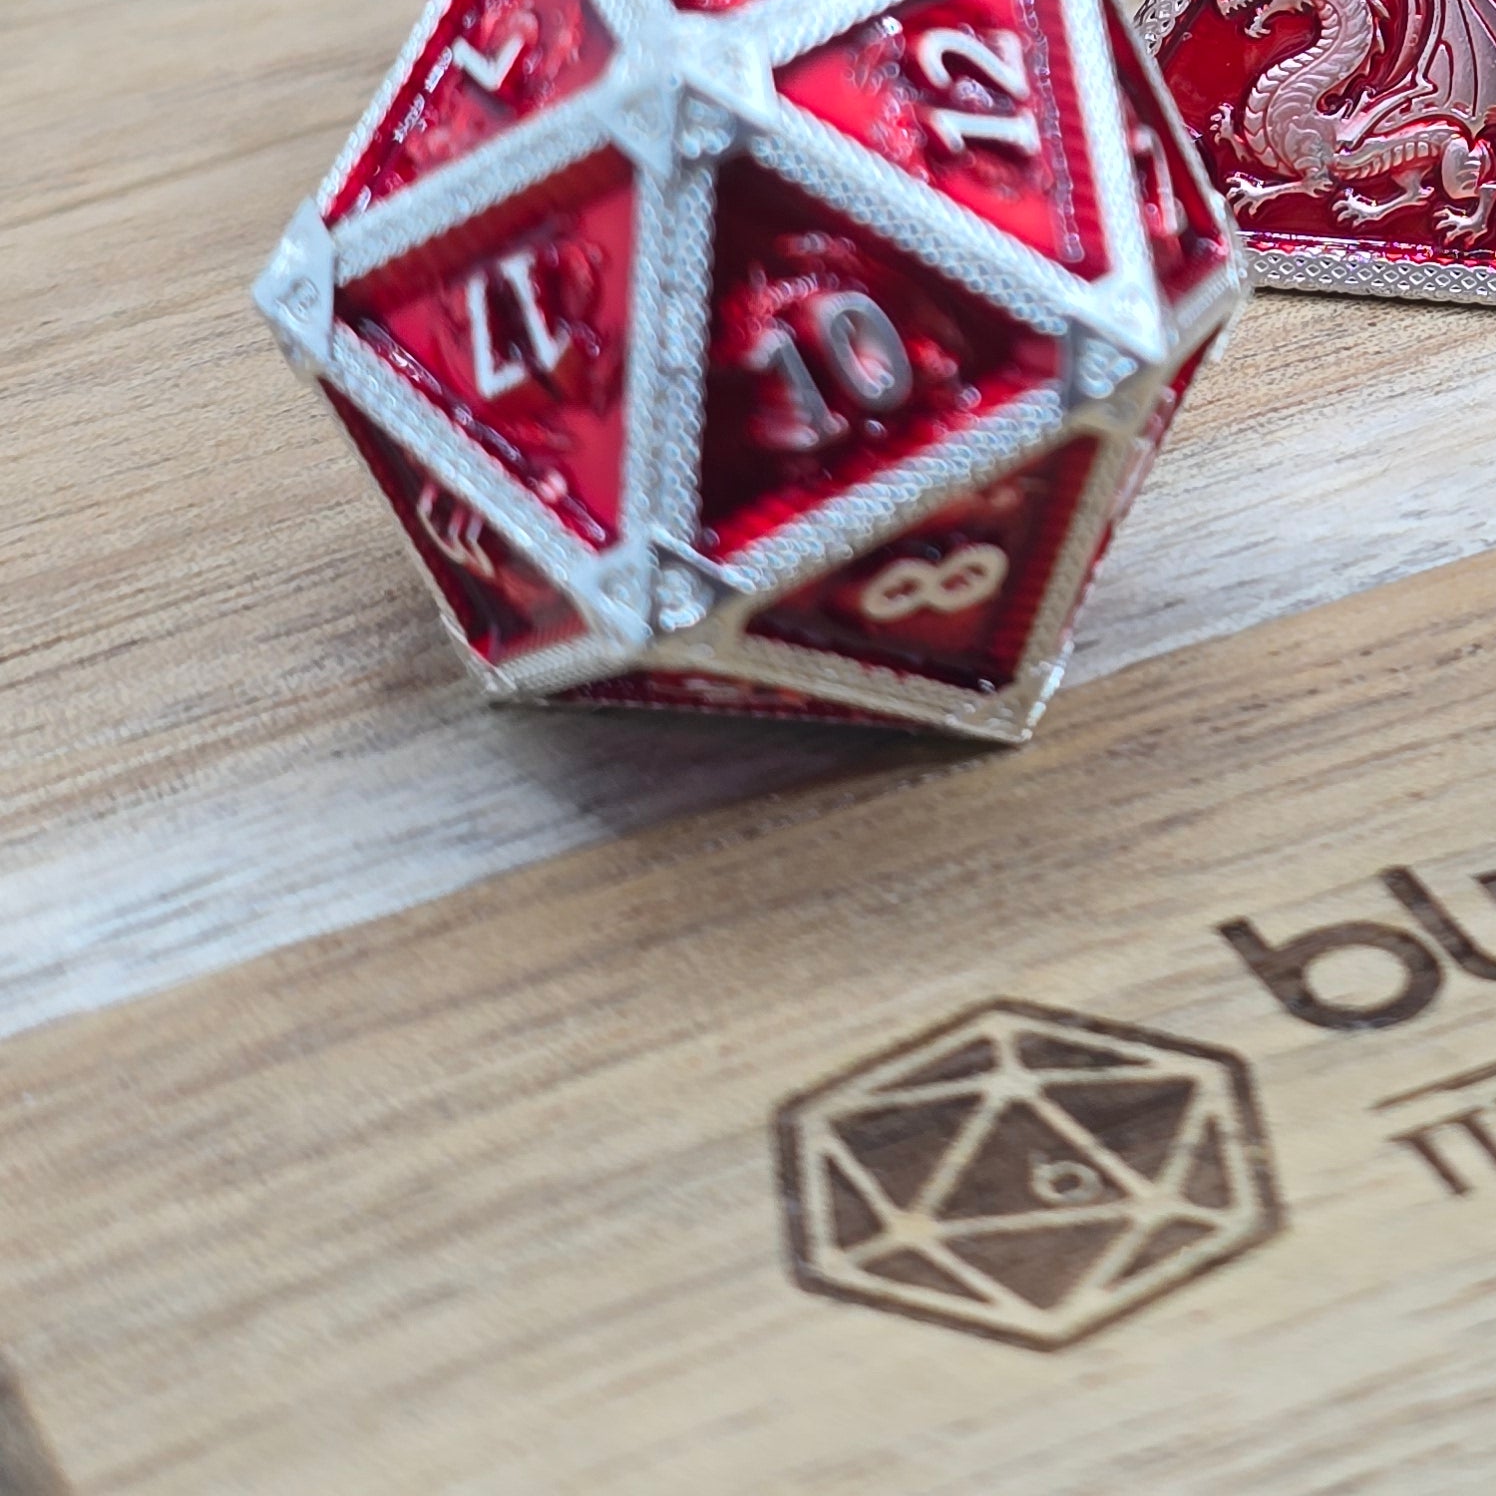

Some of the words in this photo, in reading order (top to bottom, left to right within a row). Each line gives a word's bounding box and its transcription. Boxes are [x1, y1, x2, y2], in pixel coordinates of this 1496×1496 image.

[914, 24, 1042, 160] 12
[748, 289, 912, 449] 10
[862, 544, 1010, 620] 8
